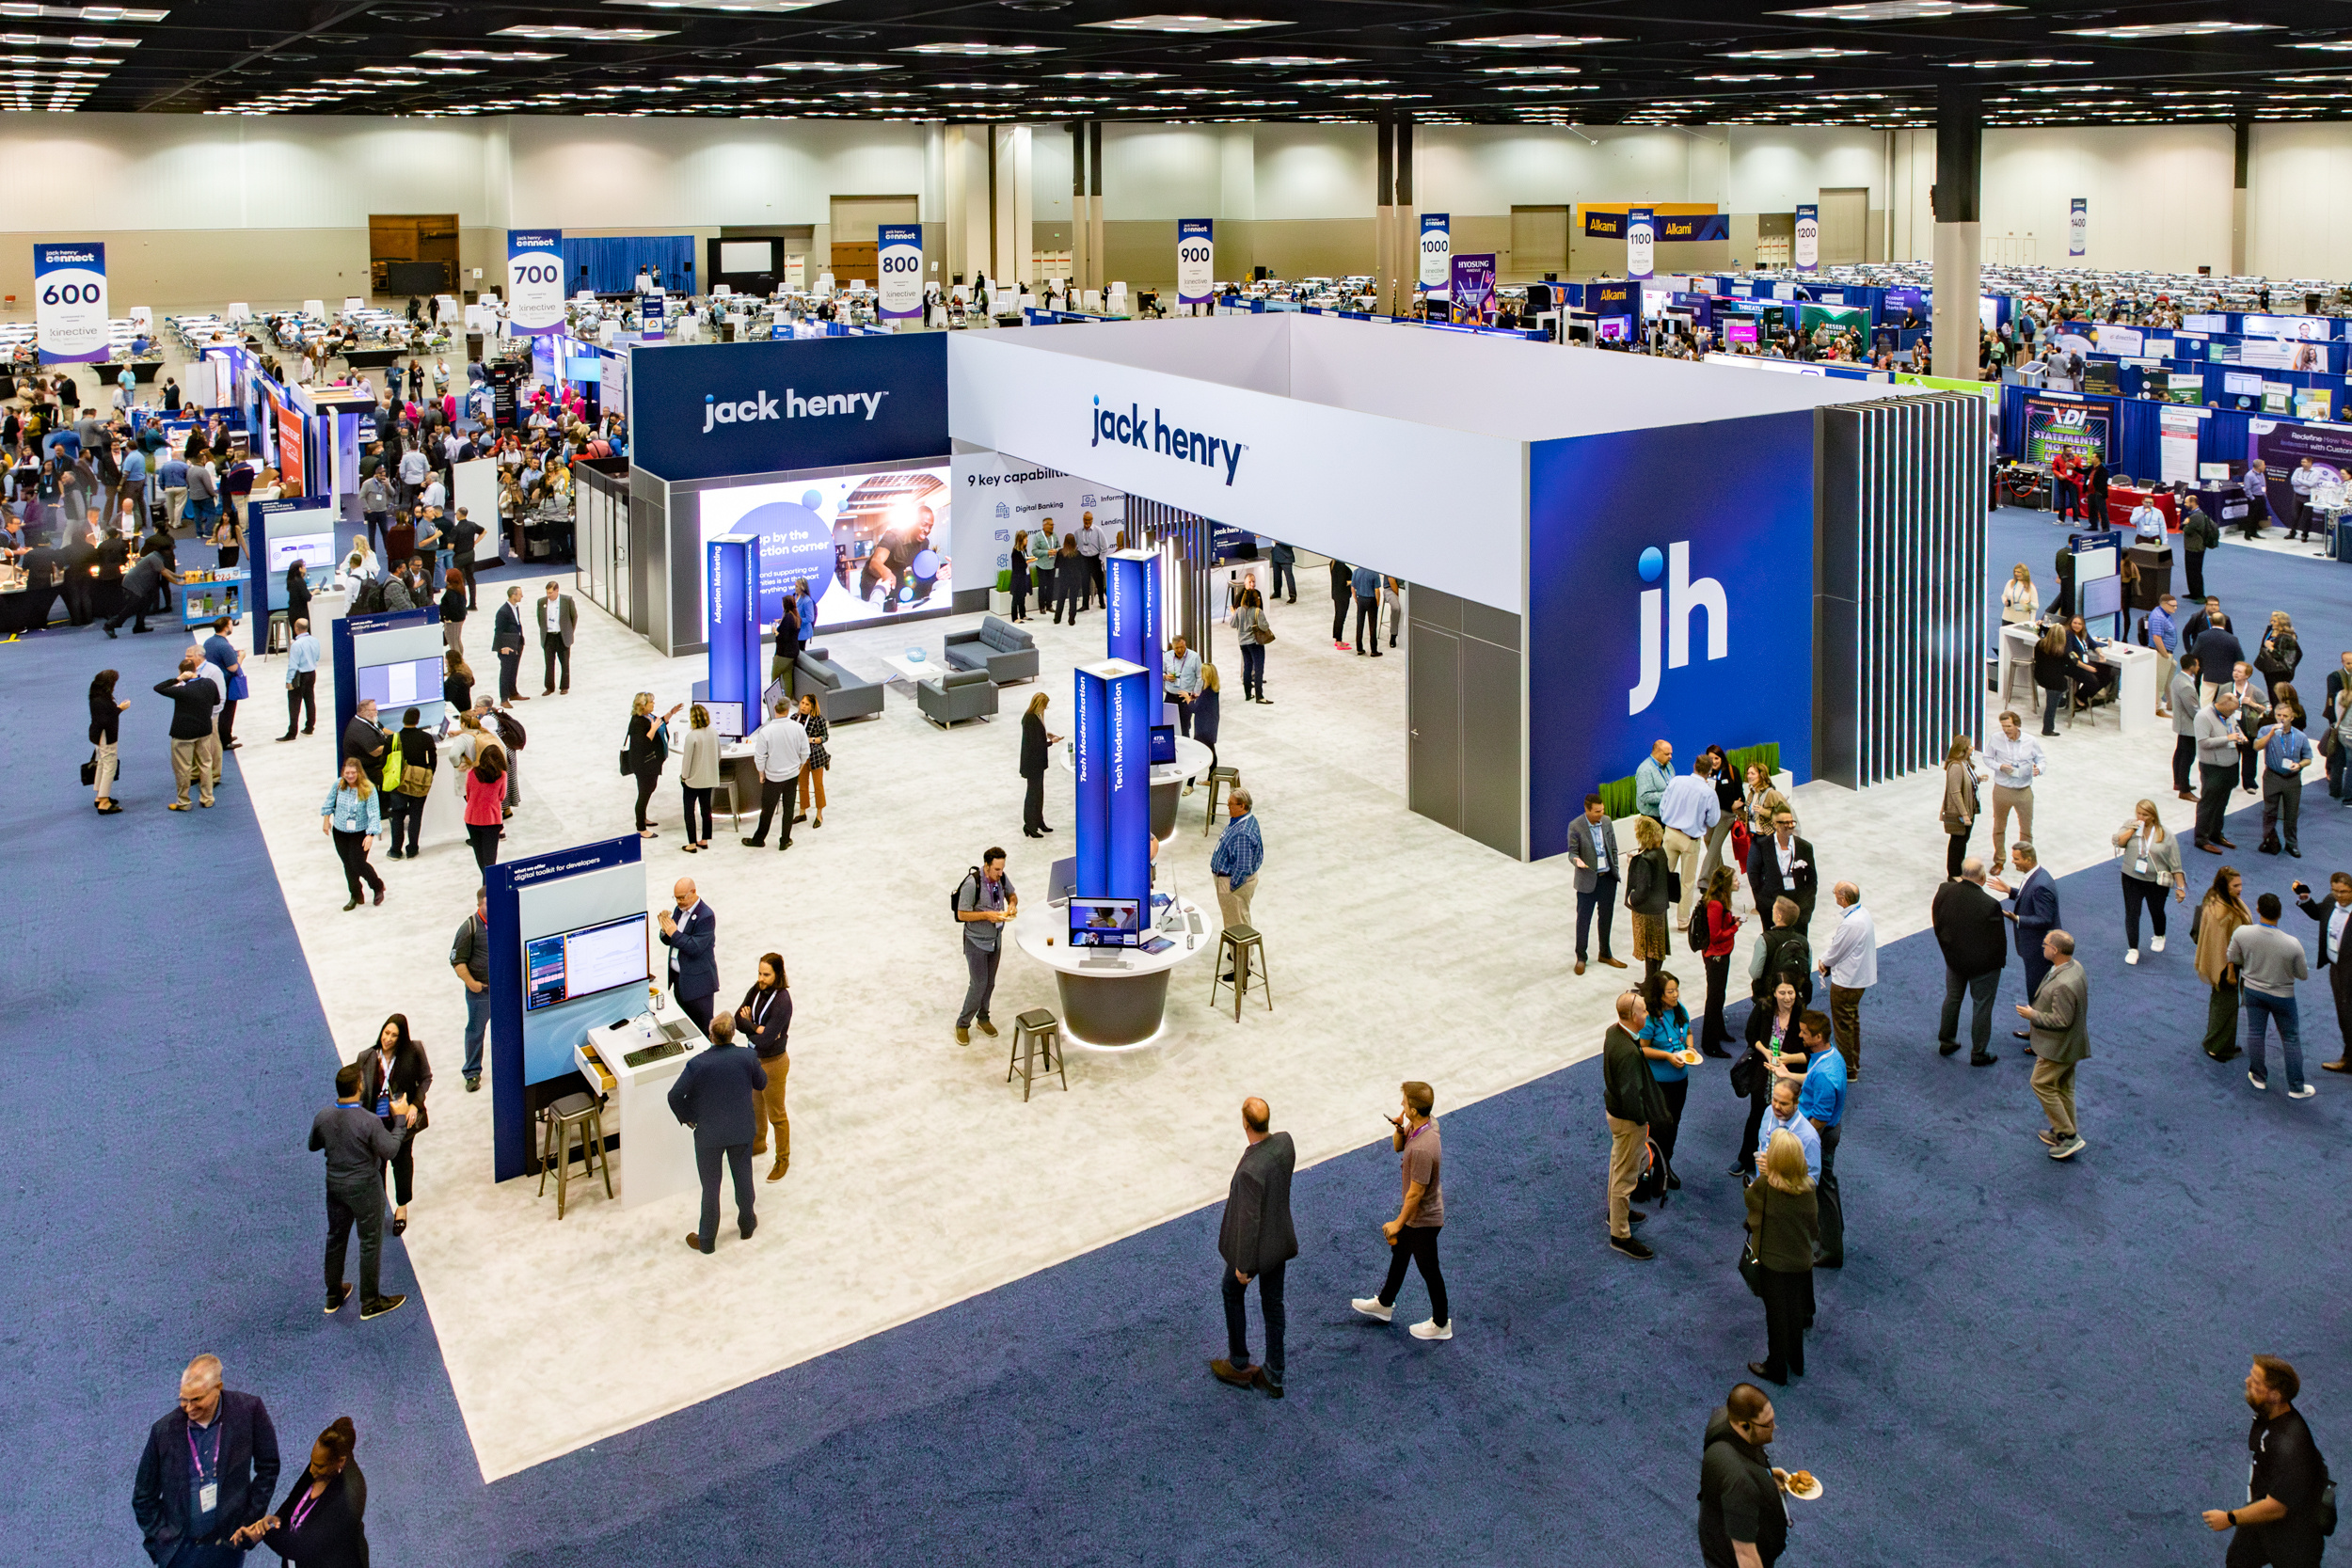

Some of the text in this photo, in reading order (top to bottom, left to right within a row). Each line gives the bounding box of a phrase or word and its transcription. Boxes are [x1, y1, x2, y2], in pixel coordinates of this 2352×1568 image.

[1590, 219, 1617, 232] Alkami
[1666, 223, 1692, 235] Alkami
[2071, 219, 2086, 227] 1400
[1630, 234, 1651, 244] 1100
[1797, 228, 1816, 238] 1200
[516, 238, 554, 247] connect
[1422, 241, 1448, 252] 1000
[46, 253, 94, 263] connect
[1181, 247, 1209, 263] 900
[883, 256, 918, 273] 800
[514, 265, 557, 284] 700
[43, 284, 100, 305] 600
[1600, 289, 1626, 301] Alkami
[49, 327, 97, 336] kinective
[703, 390, 780, 434] jack
[2046, 407, 2087, 426] XDI
[1092, 394, 1148, 449] jack
[2034, 430, 2101, 446] STATEMENTS
[2292, 432, 2322, 442] Redefine
[968, 475, 976, 487] 9
[979, 473, 1000, 487] key
[1016, 502, 1063, 513] Digital Banking
[773, 532, 787, 544] by
[789, 529, 809, 540] the
[1214, 528, 1226, 537] jack
[792, 541, 829, 553] corner
[773, 566, 807, 577] supporting
[1629, 540, 1727, 716] jh
[514, 871, 535, 881] digital
[536, 867, 555, 876] toolkit
[566, 858, 600, 869] developers
